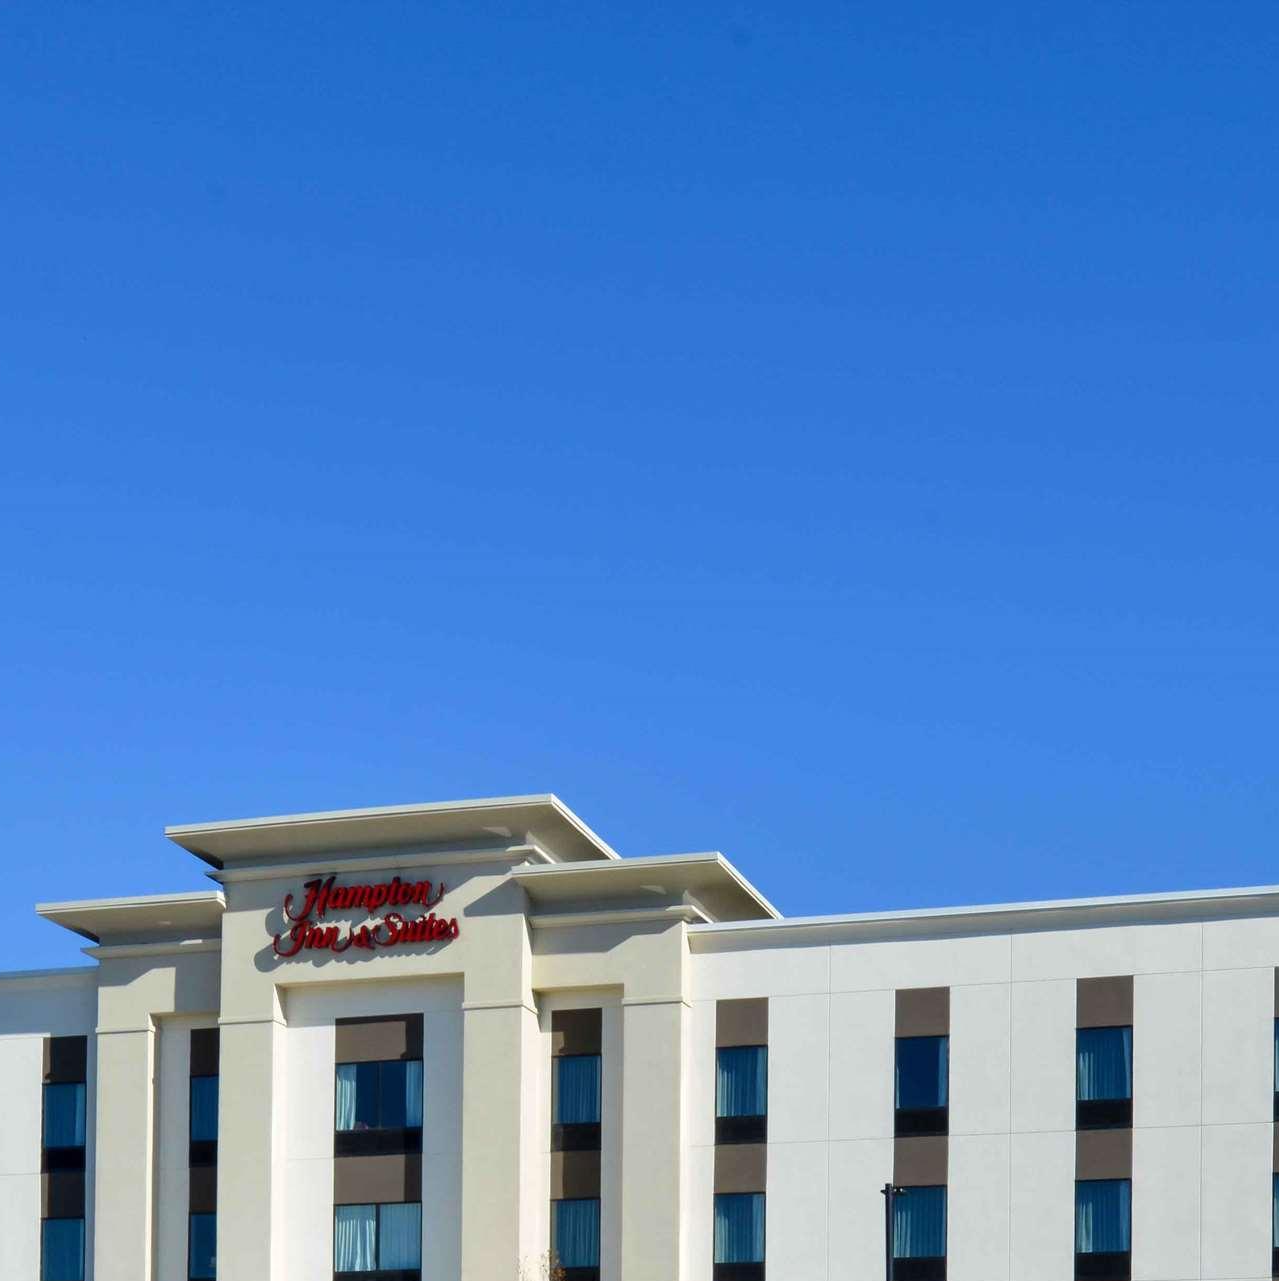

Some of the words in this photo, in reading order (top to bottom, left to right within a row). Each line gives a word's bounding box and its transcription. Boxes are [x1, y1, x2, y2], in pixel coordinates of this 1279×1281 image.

[285, 874, 444, 922] Hampton
[273, 919, 353, 957] Inn
[353, 925, 375, 950] &
[372, 912, 460, 947] Suites
